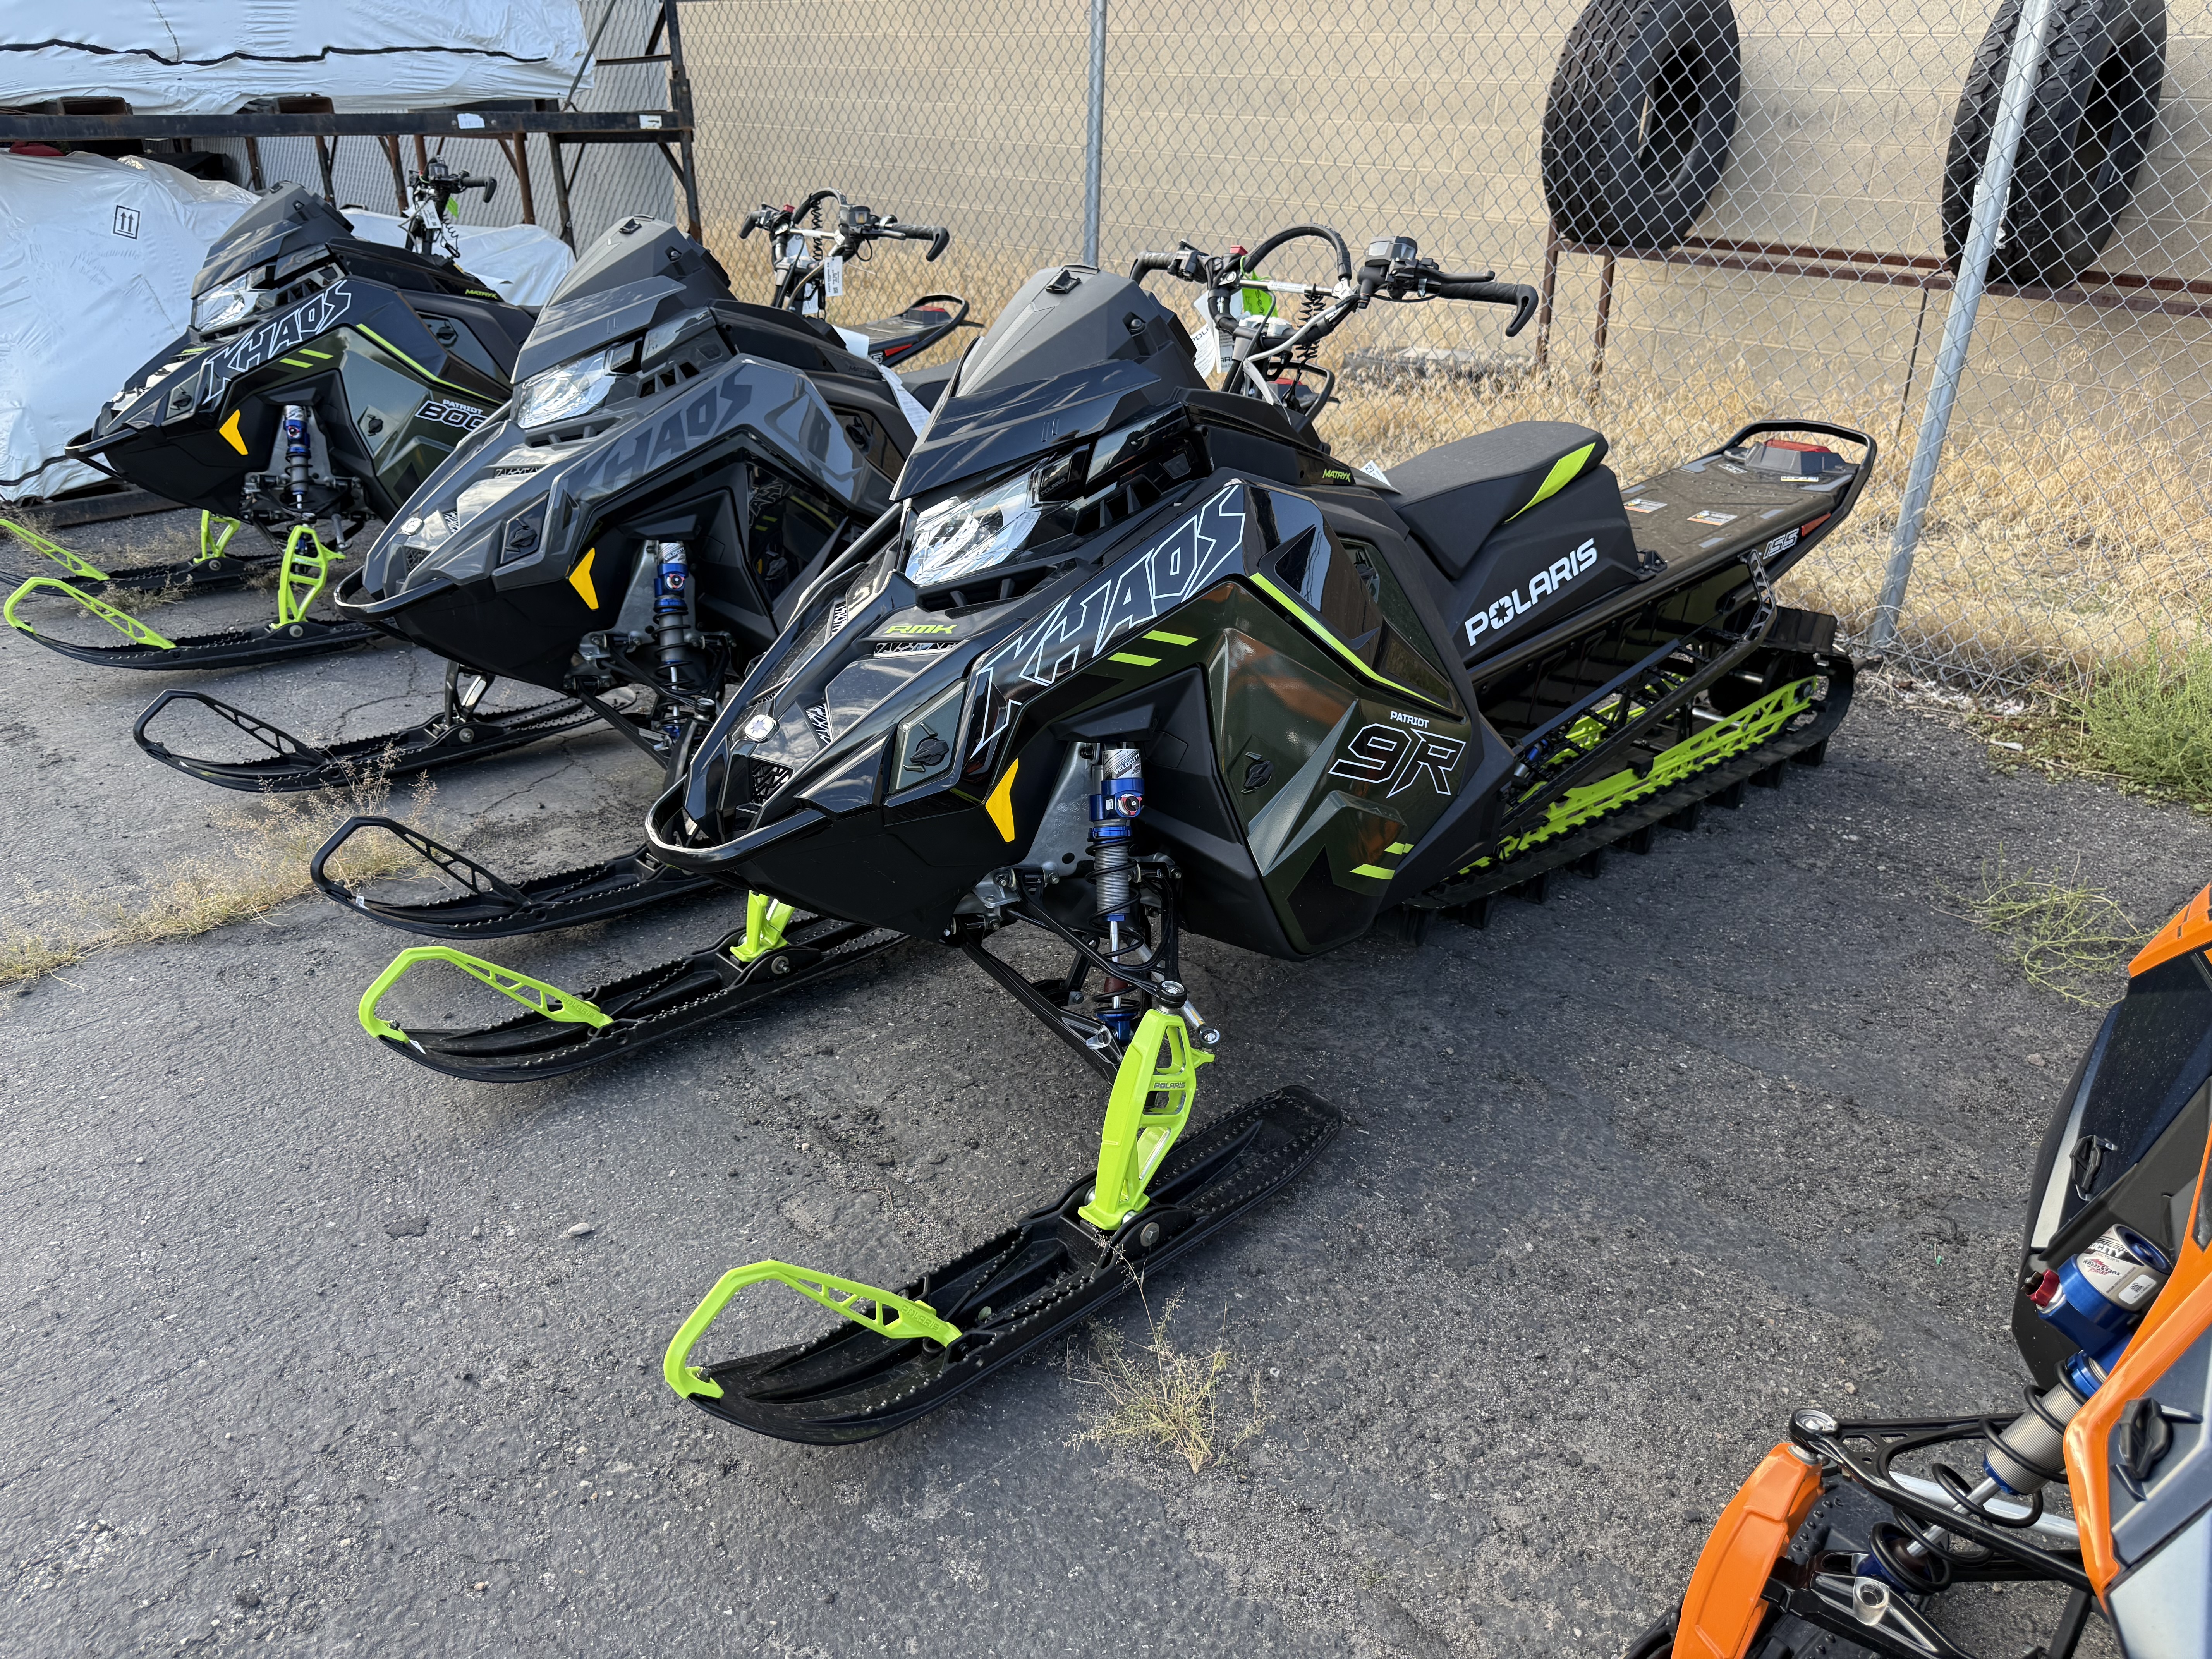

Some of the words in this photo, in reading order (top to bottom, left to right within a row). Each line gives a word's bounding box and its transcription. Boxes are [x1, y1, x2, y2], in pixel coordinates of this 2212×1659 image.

[203, 280, 352, 404] KHAOS
[443, 399, 483, 414] PATRIOT
[1040, 477, 1066, 496] POLARIS
[1322, 469, 1351, 483] MATRYX
[1763, 527, 1799, 560] 155
[1465, 538, 1598, 646] POLARIS
[883, 624, 959, 634] RMK
[970, 485, 1245, 760] KHAOS
[1390, 711, 1430, 728] PATRIOT
[1113, 752, 1140, 775] VELOCITY
[1329, 723, 1467, 798] 9R
[2100, 1265, 2121, 1276] Evans
[901, 1304, 941, 1331] POLARIS
